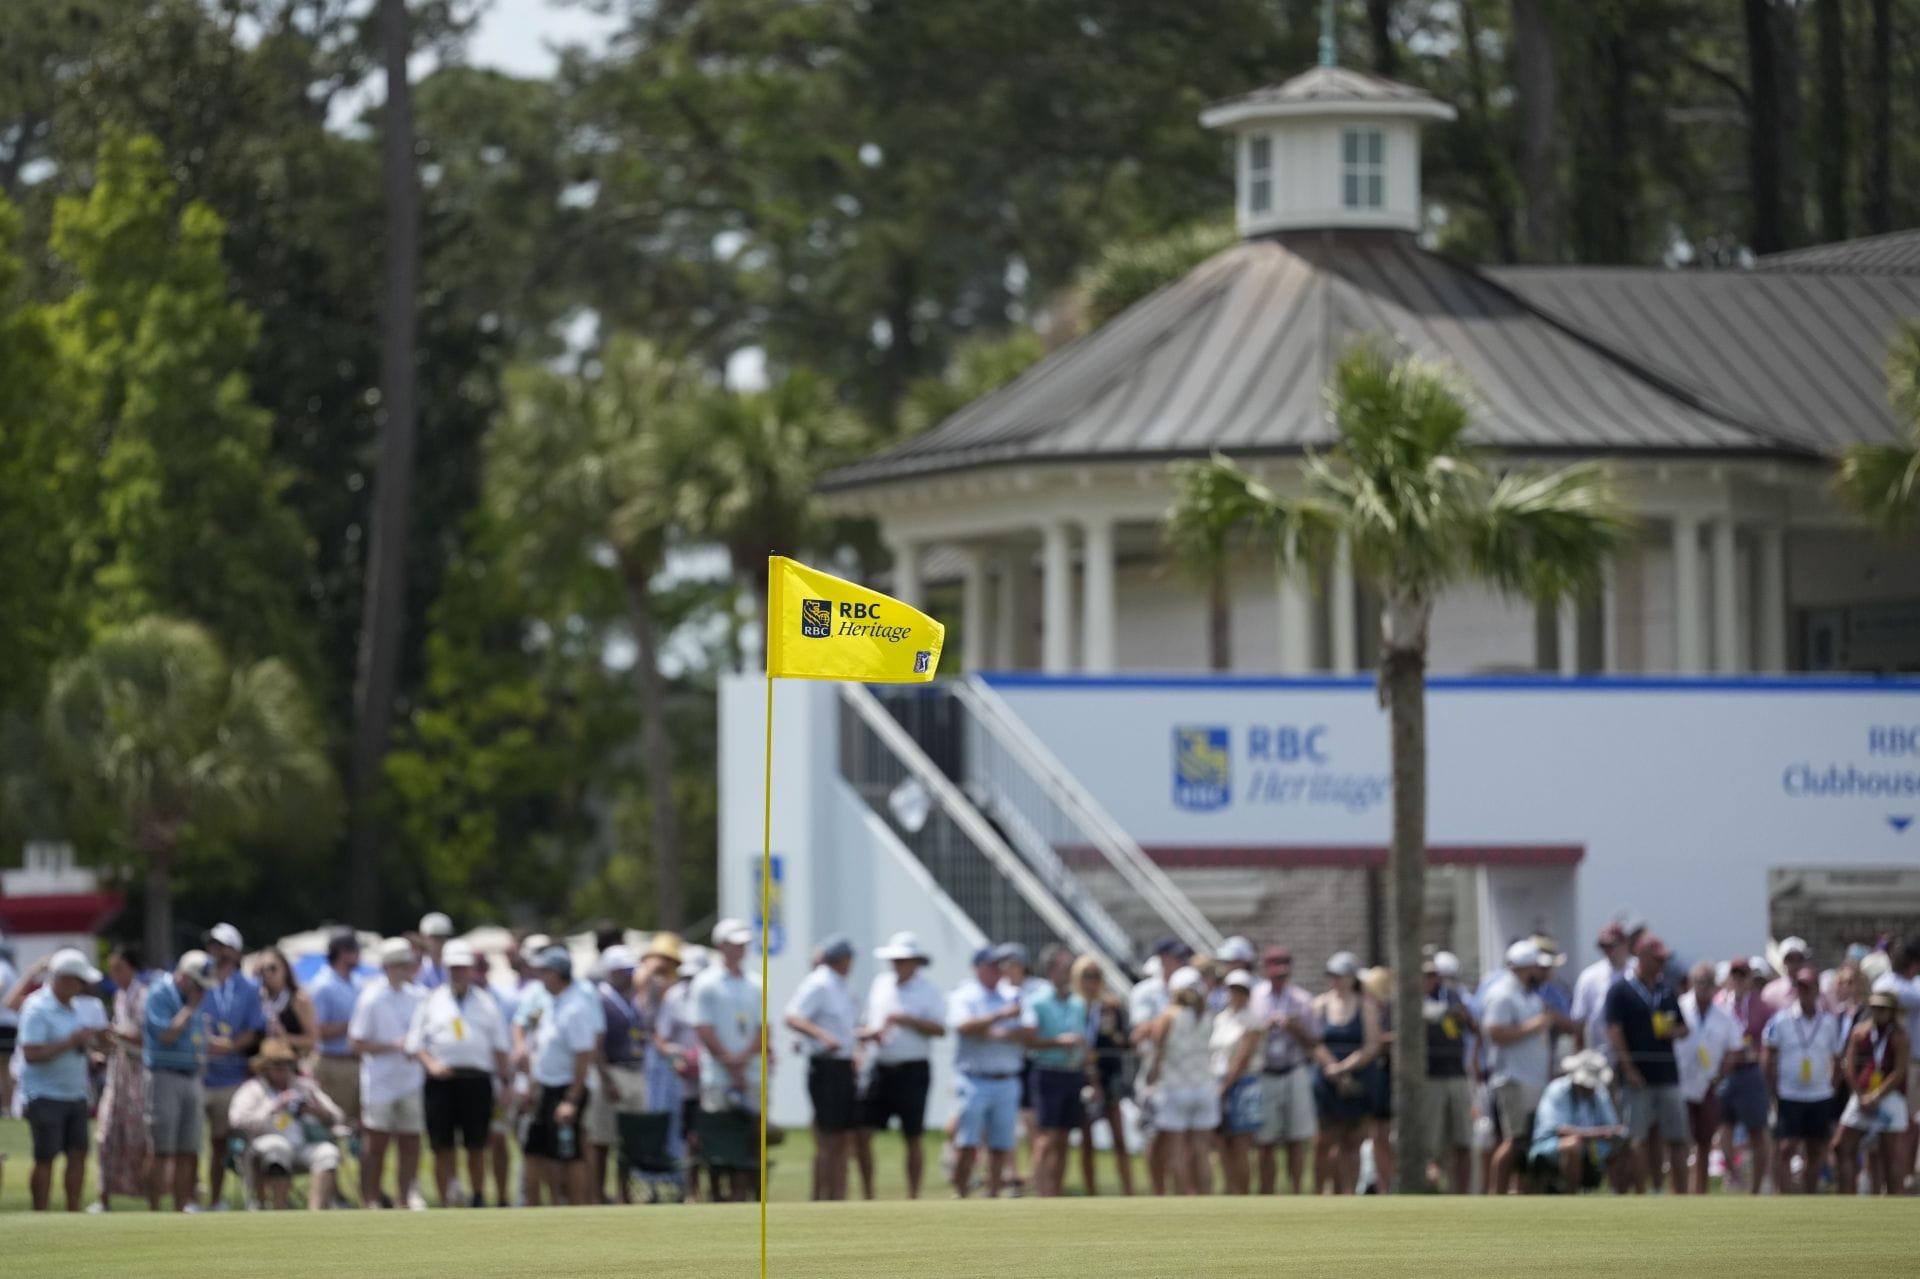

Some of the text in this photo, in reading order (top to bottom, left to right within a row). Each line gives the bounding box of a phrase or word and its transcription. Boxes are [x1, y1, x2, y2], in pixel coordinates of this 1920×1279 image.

[839, 602, 881, 619] RBC
[804, 626, 829, 636] RBC
[838, 621, 911, 642] Heritage
[1248, 724, 1328, 763] RBC
[1782, 762, 1920, 798] Clubhous
